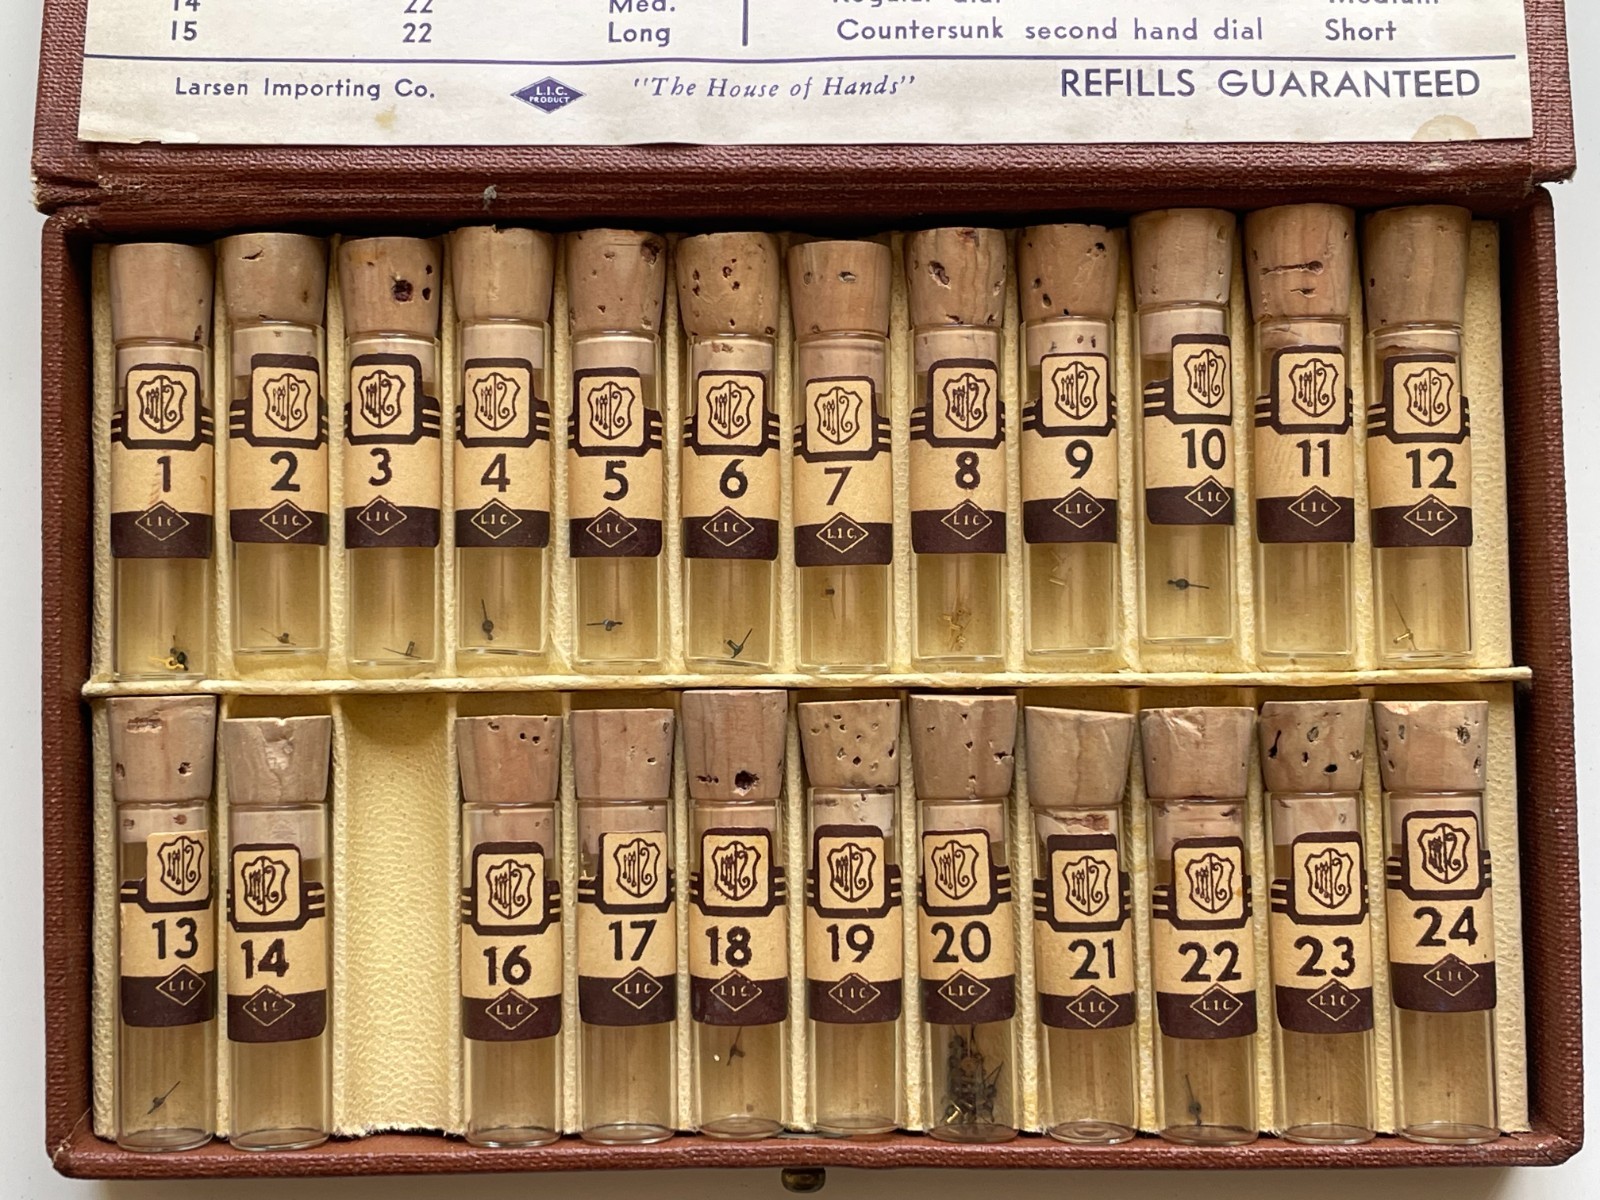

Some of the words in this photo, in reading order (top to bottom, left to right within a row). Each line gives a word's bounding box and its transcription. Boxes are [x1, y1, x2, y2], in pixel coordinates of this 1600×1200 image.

[609, 0, 676, 14] Med.
[171, 20, 198, 42] 15
[402, 22, 432, 43] 22
[608, 21, 671, 48] Long
[836, 16, 1004, 41] Countersunk
[1025, 16, 1117, 40] second
[1134, 17, 1198, 41] hand
[1213, 16, 1263, 40] dial
[1325, 17, 1397, 41] Short
[175, 76, 248, 96] Larsen
[264, 77, 381, 101] Importing
[394, 78, 435, 99] Co.
[529, 96, 570, 104] PRODUCT
[706, 77, 779, 98] House
[790, 76, 813, 100] of
[1061, 68, 1195, 97] REFILLS
[1217, 69, 1480, 98] GUARANTEED
[367, 447, 392, 486] 3
[1065, 439, 1094, 479] 9
[1181, 427, 1226, 470] 10
[1296, 438, 1331, 477] 11
[1406, 448, 1457, 489] 12
[157, 455, 171, 493] 1
[269, 450, 301, 492] 2
[480, 453, 511, 493] 4
[603, 459, 629, 501] 5
[719, 458, 748, 499] 6
[824, 467, 852, 506] 7
[955, 451, 981, 489] 8
[151, 916, 199, 960] 13
[608, 919, 657, 962] 17
[705, 925, 752, 967] 18
[826, 924, 875, 963] 19
[930, 921, 991, 963] 20
[1414, 906, 1478, 947] 24
[240, 938, 290, 979] 14
[483, 944, 531, 986] 16
[1068, 938, 1116, 980] 21
[1178, 941, 1242, 982] 22
[1294, 935, 1356, 978] 23
